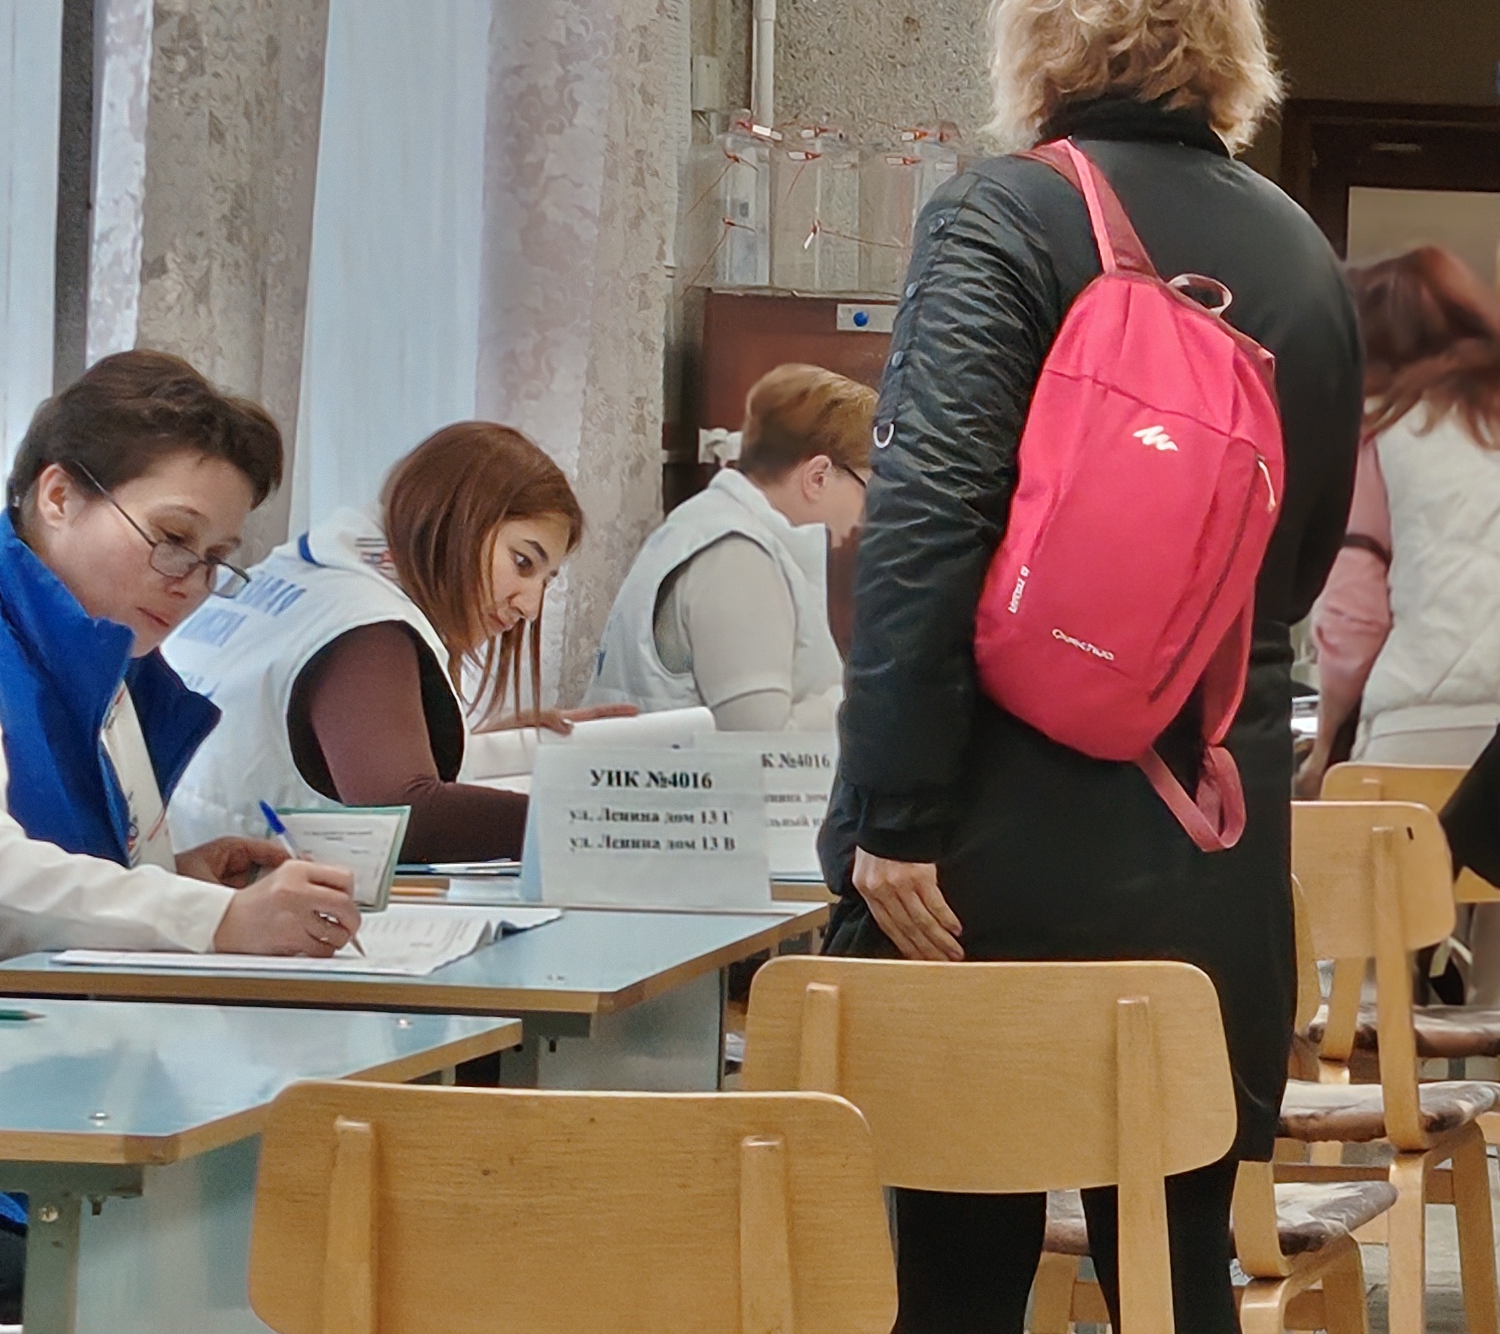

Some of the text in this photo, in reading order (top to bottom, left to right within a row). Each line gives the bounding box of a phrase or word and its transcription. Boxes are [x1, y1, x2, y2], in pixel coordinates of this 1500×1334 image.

[590, 768, 713, 789] УИК №4016
[597, 807, 660, 823] Ленина
[597, 833, 661, 850] Ленина
[724, 836, 736, 852] В
